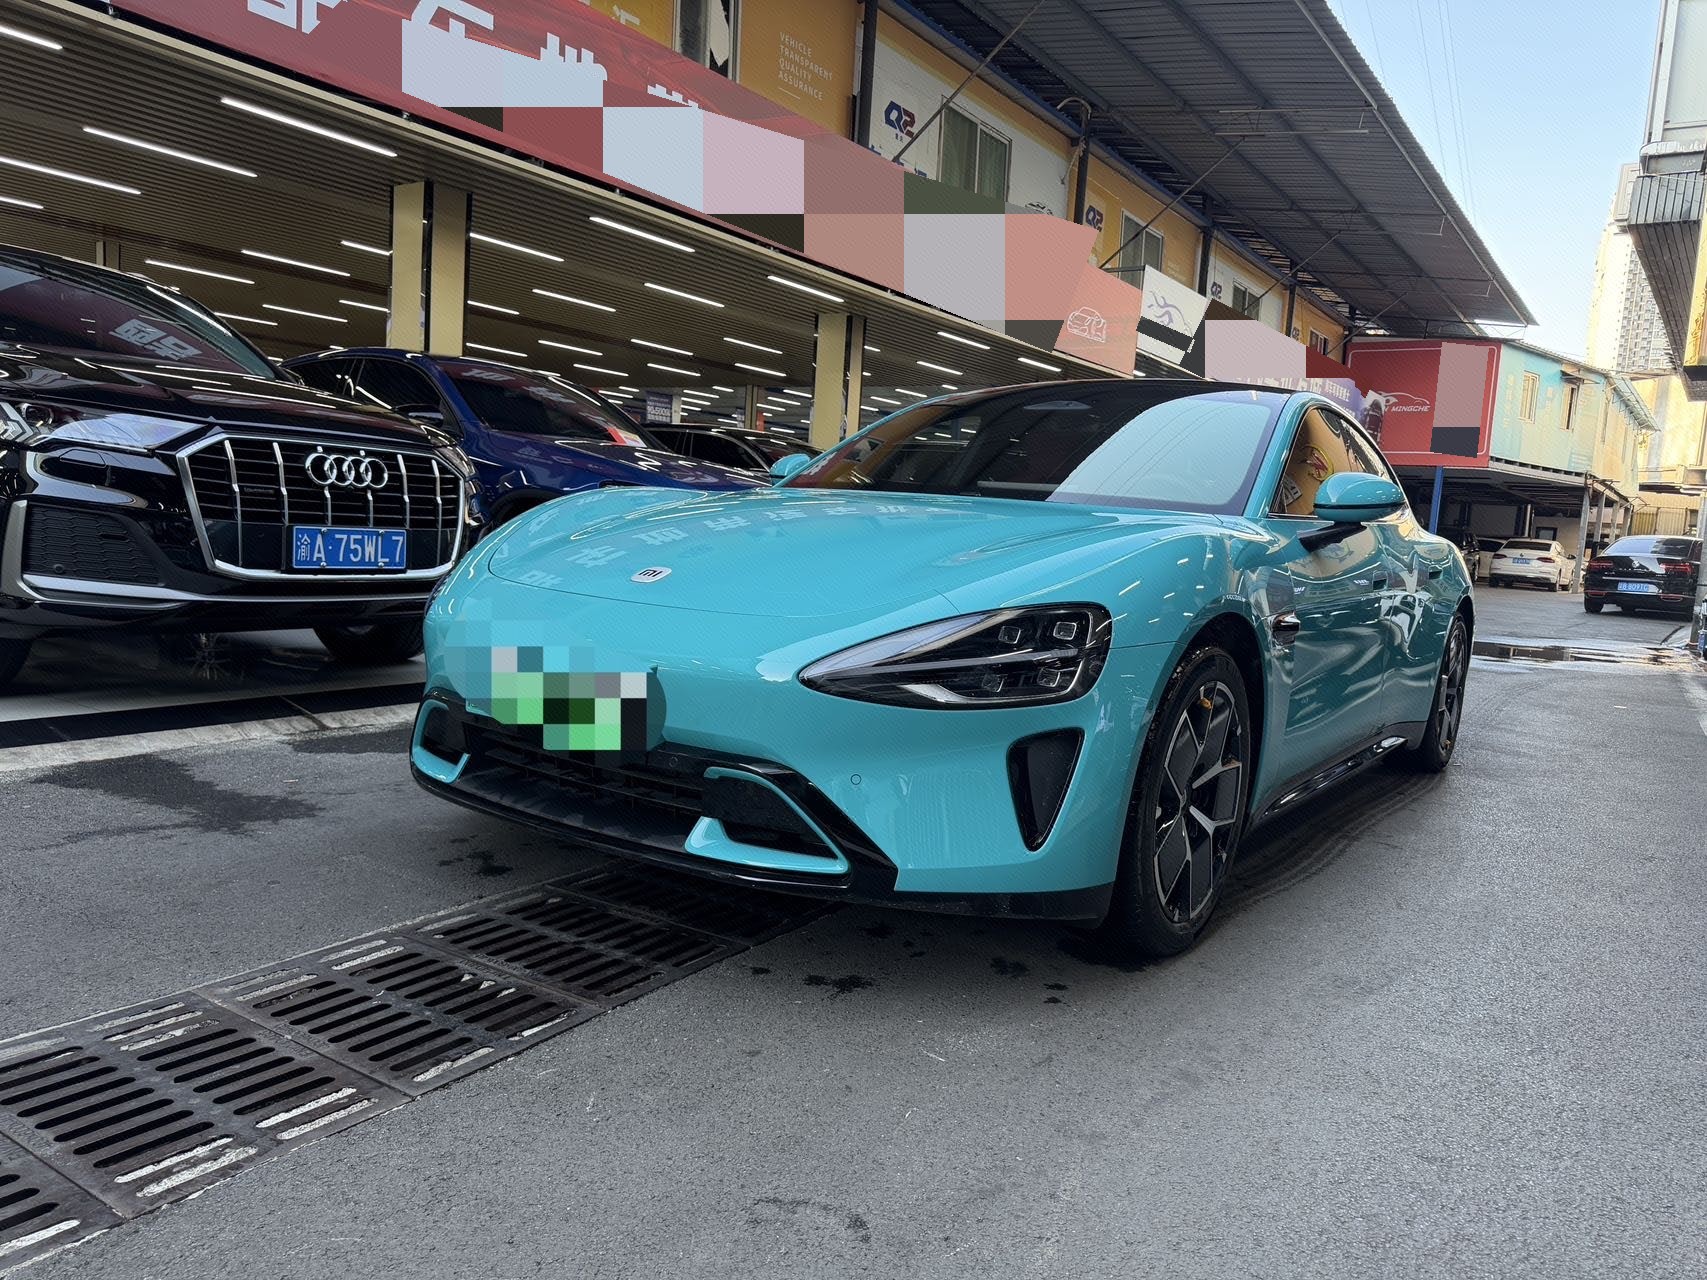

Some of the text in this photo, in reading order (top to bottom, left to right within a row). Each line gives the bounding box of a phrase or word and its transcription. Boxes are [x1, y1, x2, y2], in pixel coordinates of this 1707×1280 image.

[780, 31, 812, 58] VEHICLE
[780, 45, 832, 80] TRANSPARENT
[780, 58, 812, 81] QUALITY
[779, 71, 824, 101] ASSURANCE
